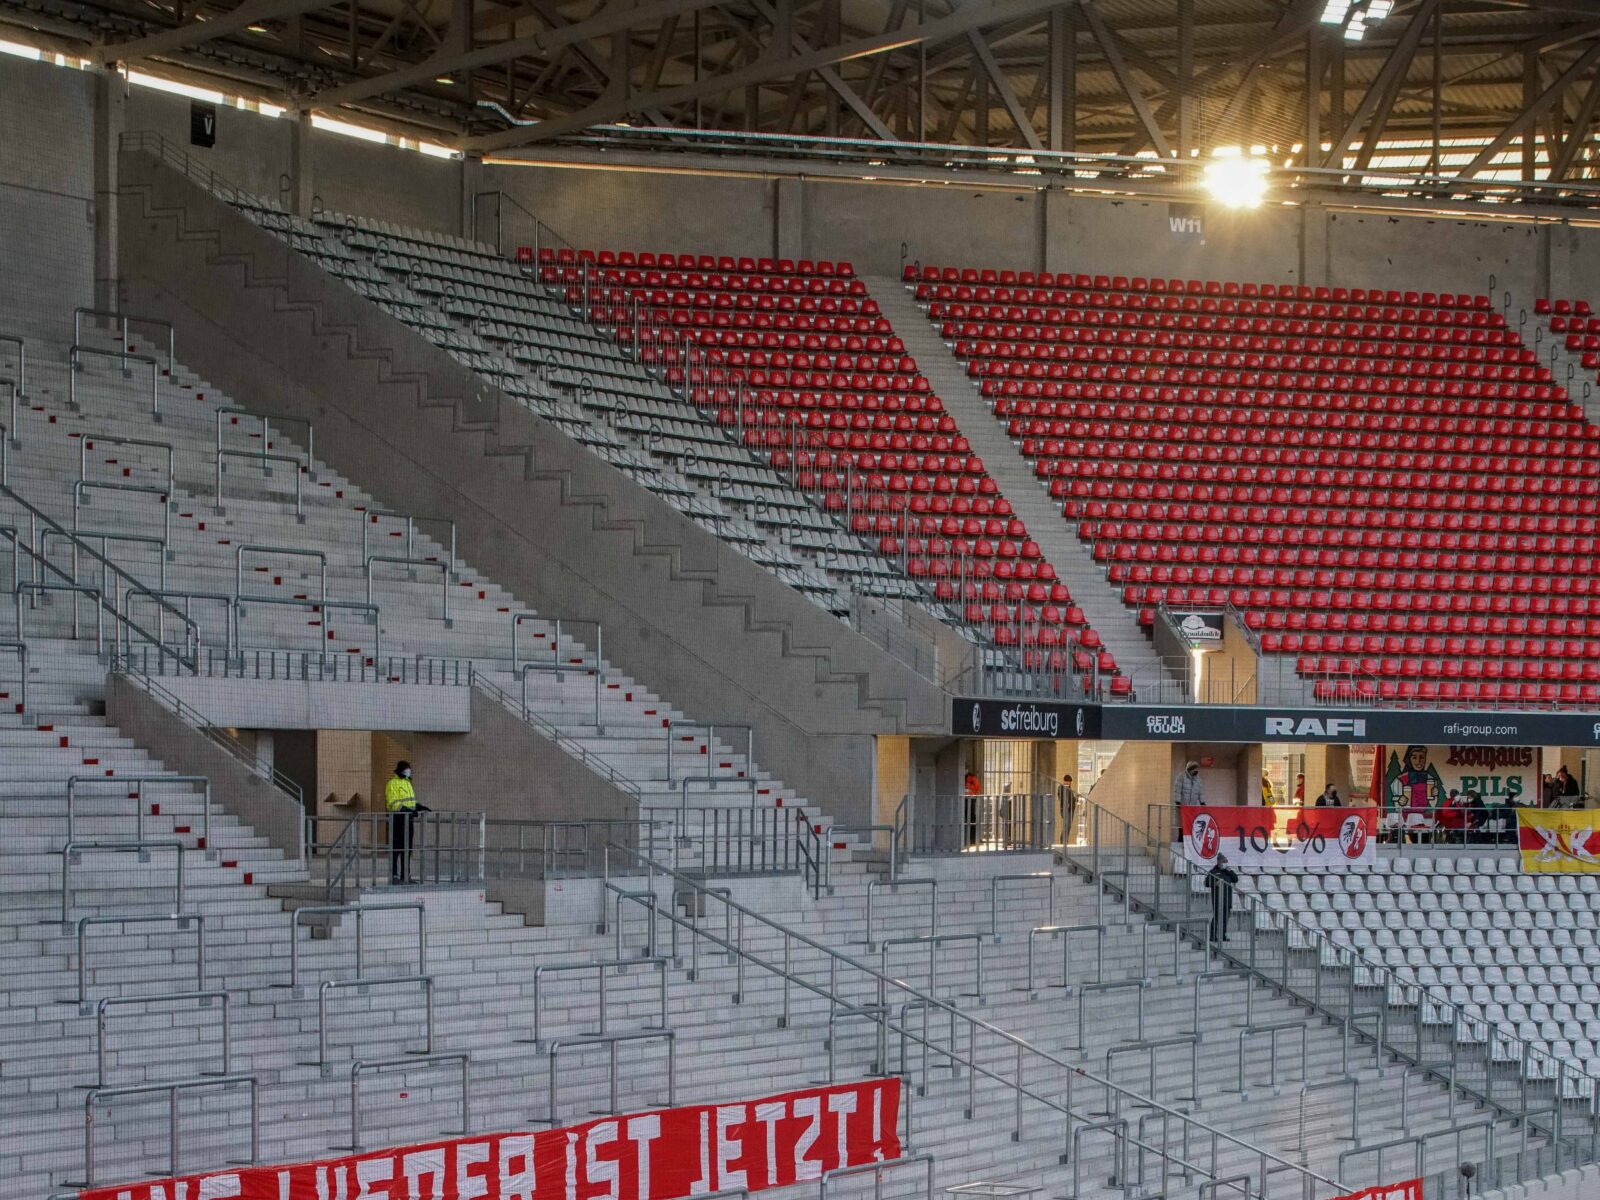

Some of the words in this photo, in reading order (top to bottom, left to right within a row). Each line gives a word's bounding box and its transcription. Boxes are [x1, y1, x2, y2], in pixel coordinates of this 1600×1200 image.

[1169, 217, 1201, 233] W11
[1146, 716, 1168, 727] GET
[1171, 716, 1183, 727] IN
[1147, 724, 1186, 734] TOUCH
[1265, 717, 1366, 737] RAFI
[1443, 723, 1517, 736] rafi-group.com
[1459, 775, 1523, 797] PILS
[689, 1086, 884, 1192] JETZT!
